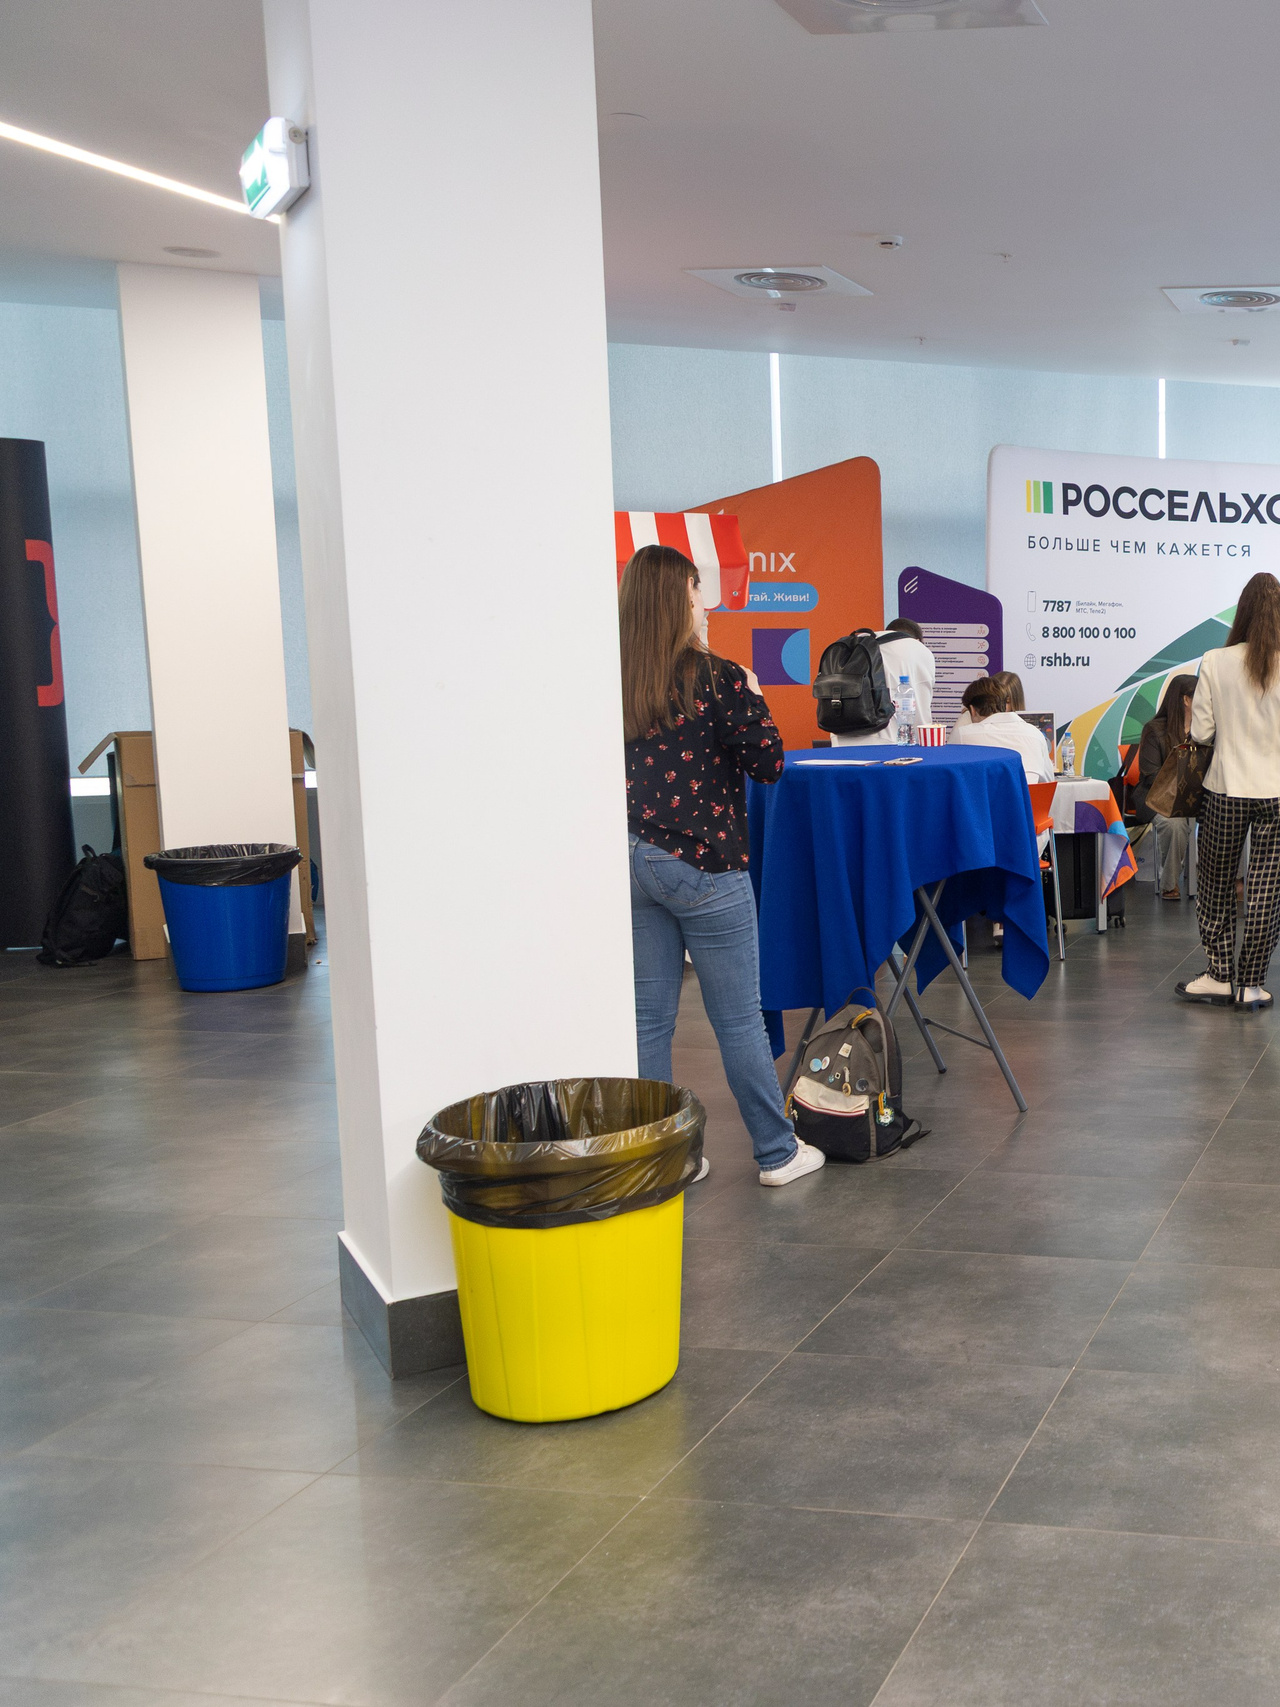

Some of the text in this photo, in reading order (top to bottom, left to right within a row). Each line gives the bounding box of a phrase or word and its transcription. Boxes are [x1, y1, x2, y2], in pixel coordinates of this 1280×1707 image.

[1027, 535, 1251, 557] БОЛЬШЕ ЧЕМ КАЖЕТСЯ
[749, 551, 797, 573] nix
[749, 592, 810, 602] тай. Живи!
[1042, 600, 1072, 612] 7787
[1042, 626, 1137, 639] 8 800 100 0 100
[1040, 652, 1090, 667] rshb.ru
